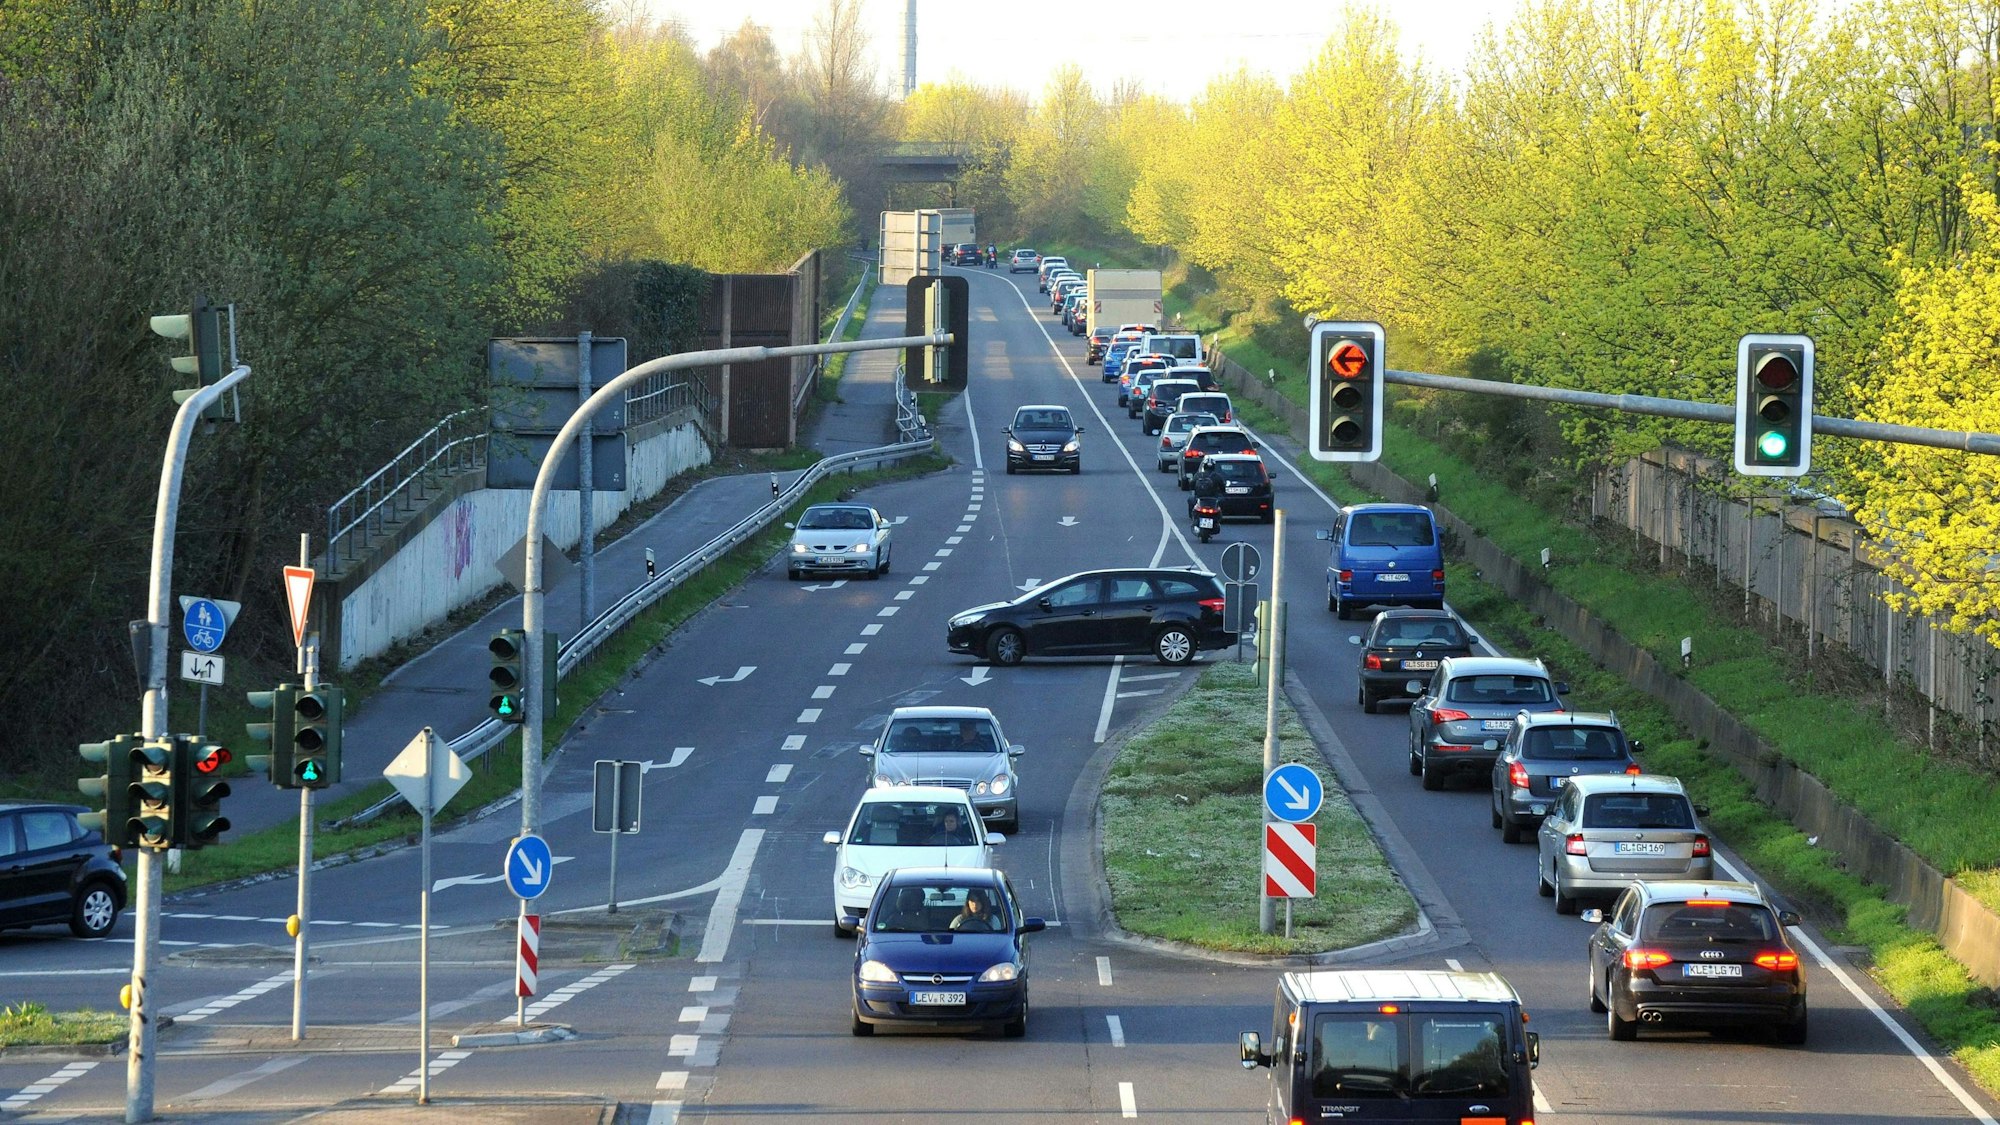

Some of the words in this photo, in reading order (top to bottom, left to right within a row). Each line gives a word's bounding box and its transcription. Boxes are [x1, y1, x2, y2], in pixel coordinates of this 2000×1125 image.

[1620, 843, 1631, 851] GL
[1636, 843, 1648, 851] GH
[1650, 844, 1664, 852] 169
[1689, 965, 1708, 975] KLE
[1714, 966, 1727, 975] LG
[1728, 966, 1741, 975] 70
[915, 993, 933, 1003] LEV
[940, 993, 945, 1003] R
[947, 993, 964, 1003] 392
